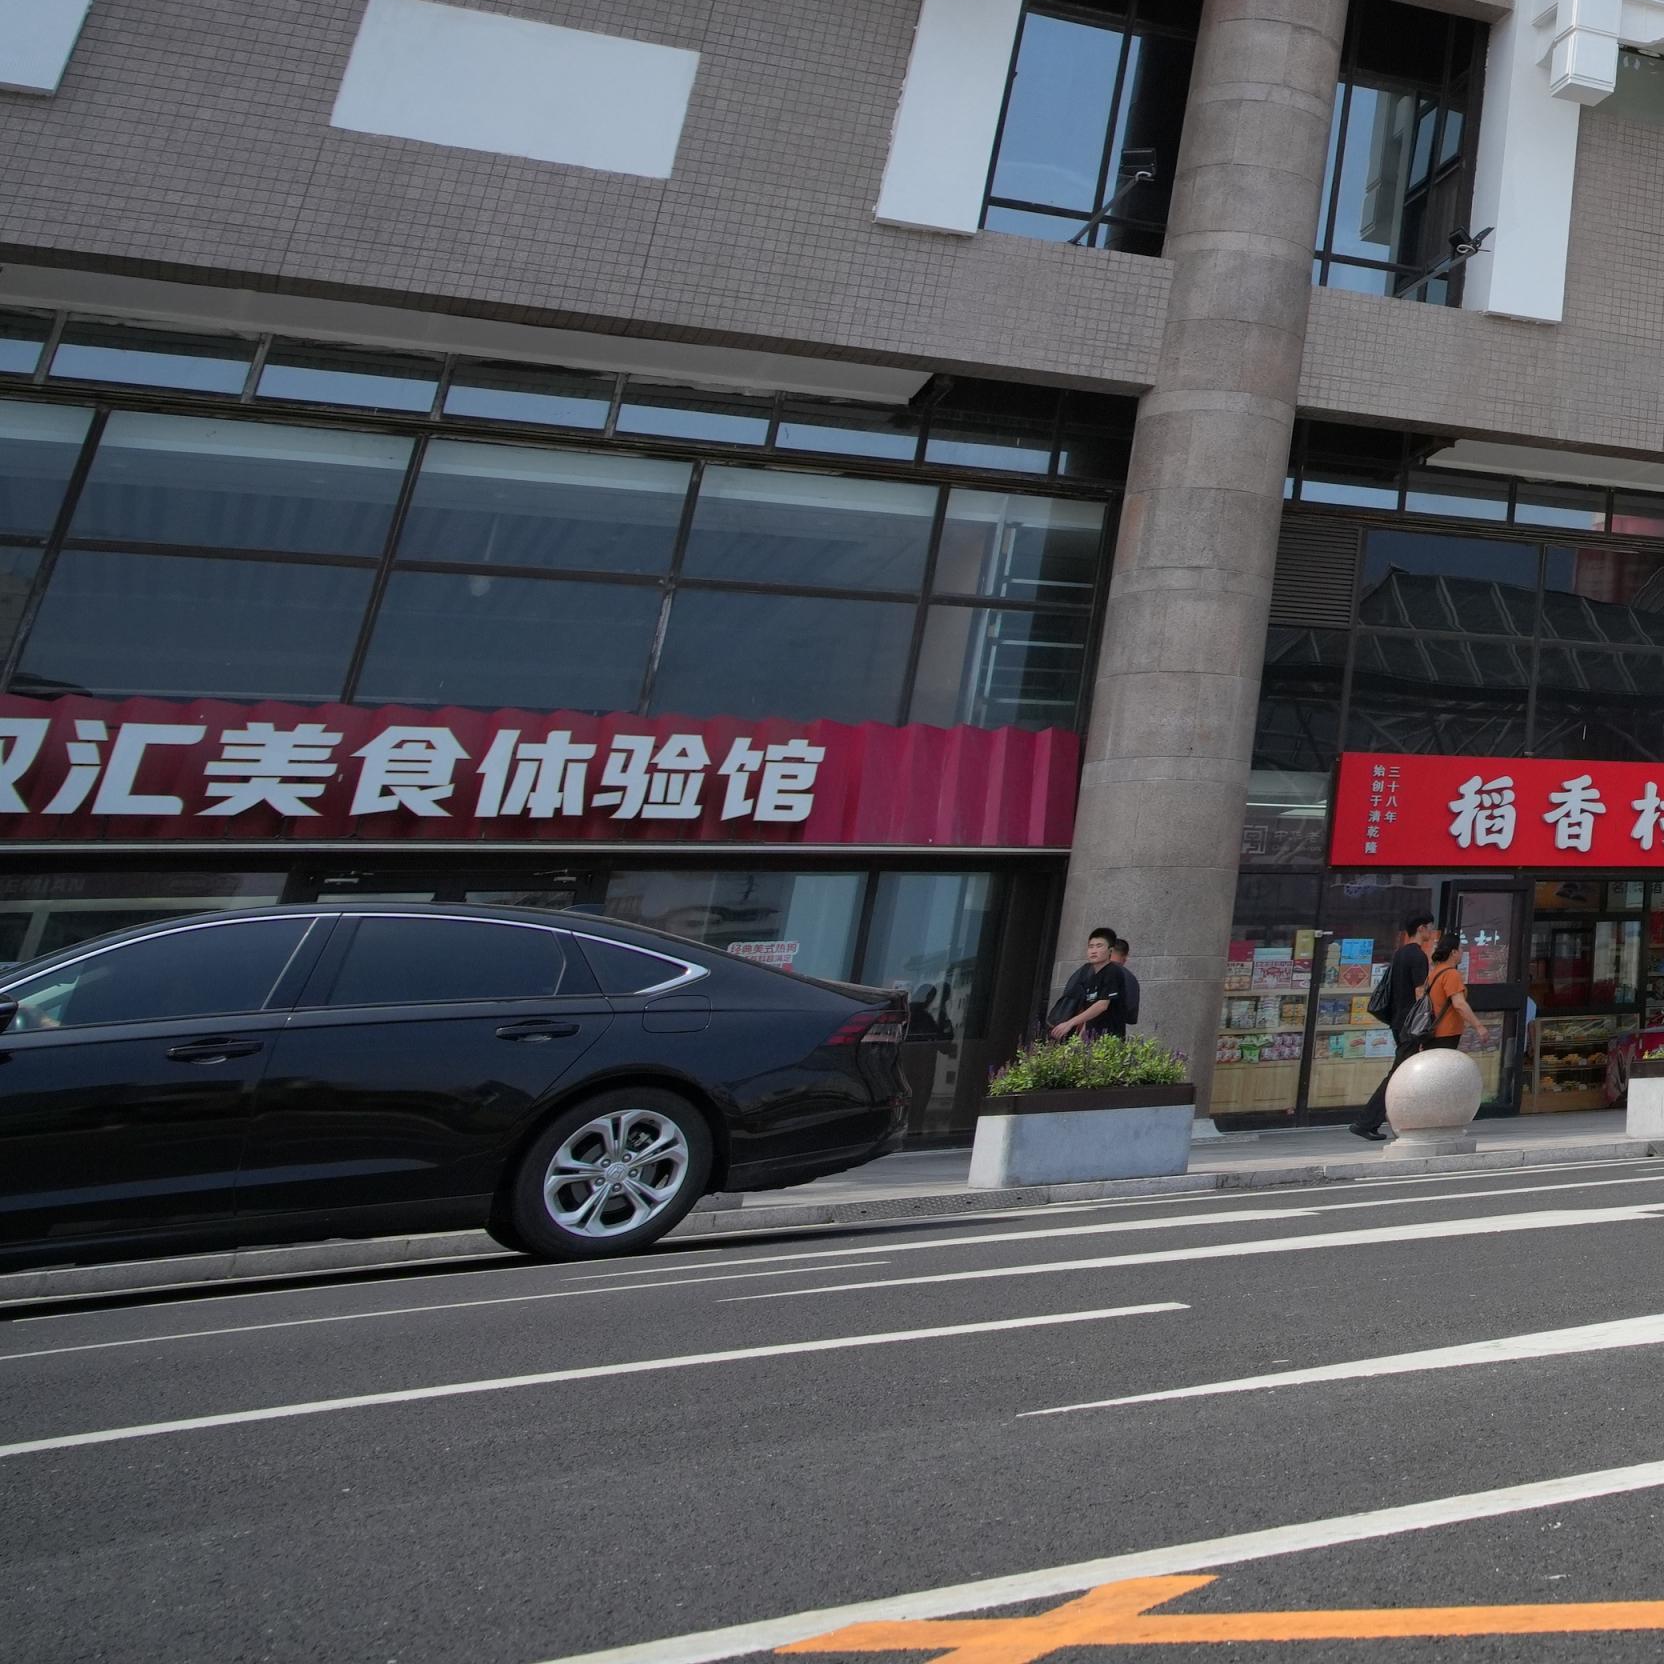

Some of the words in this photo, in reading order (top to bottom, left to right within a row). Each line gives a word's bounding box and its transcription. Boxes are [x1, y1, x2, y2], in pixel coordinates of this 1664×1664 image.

[1364, 764, 1386, 854] 始创于清乾隆
[1384, 765, 1401, 824] 三十八年
